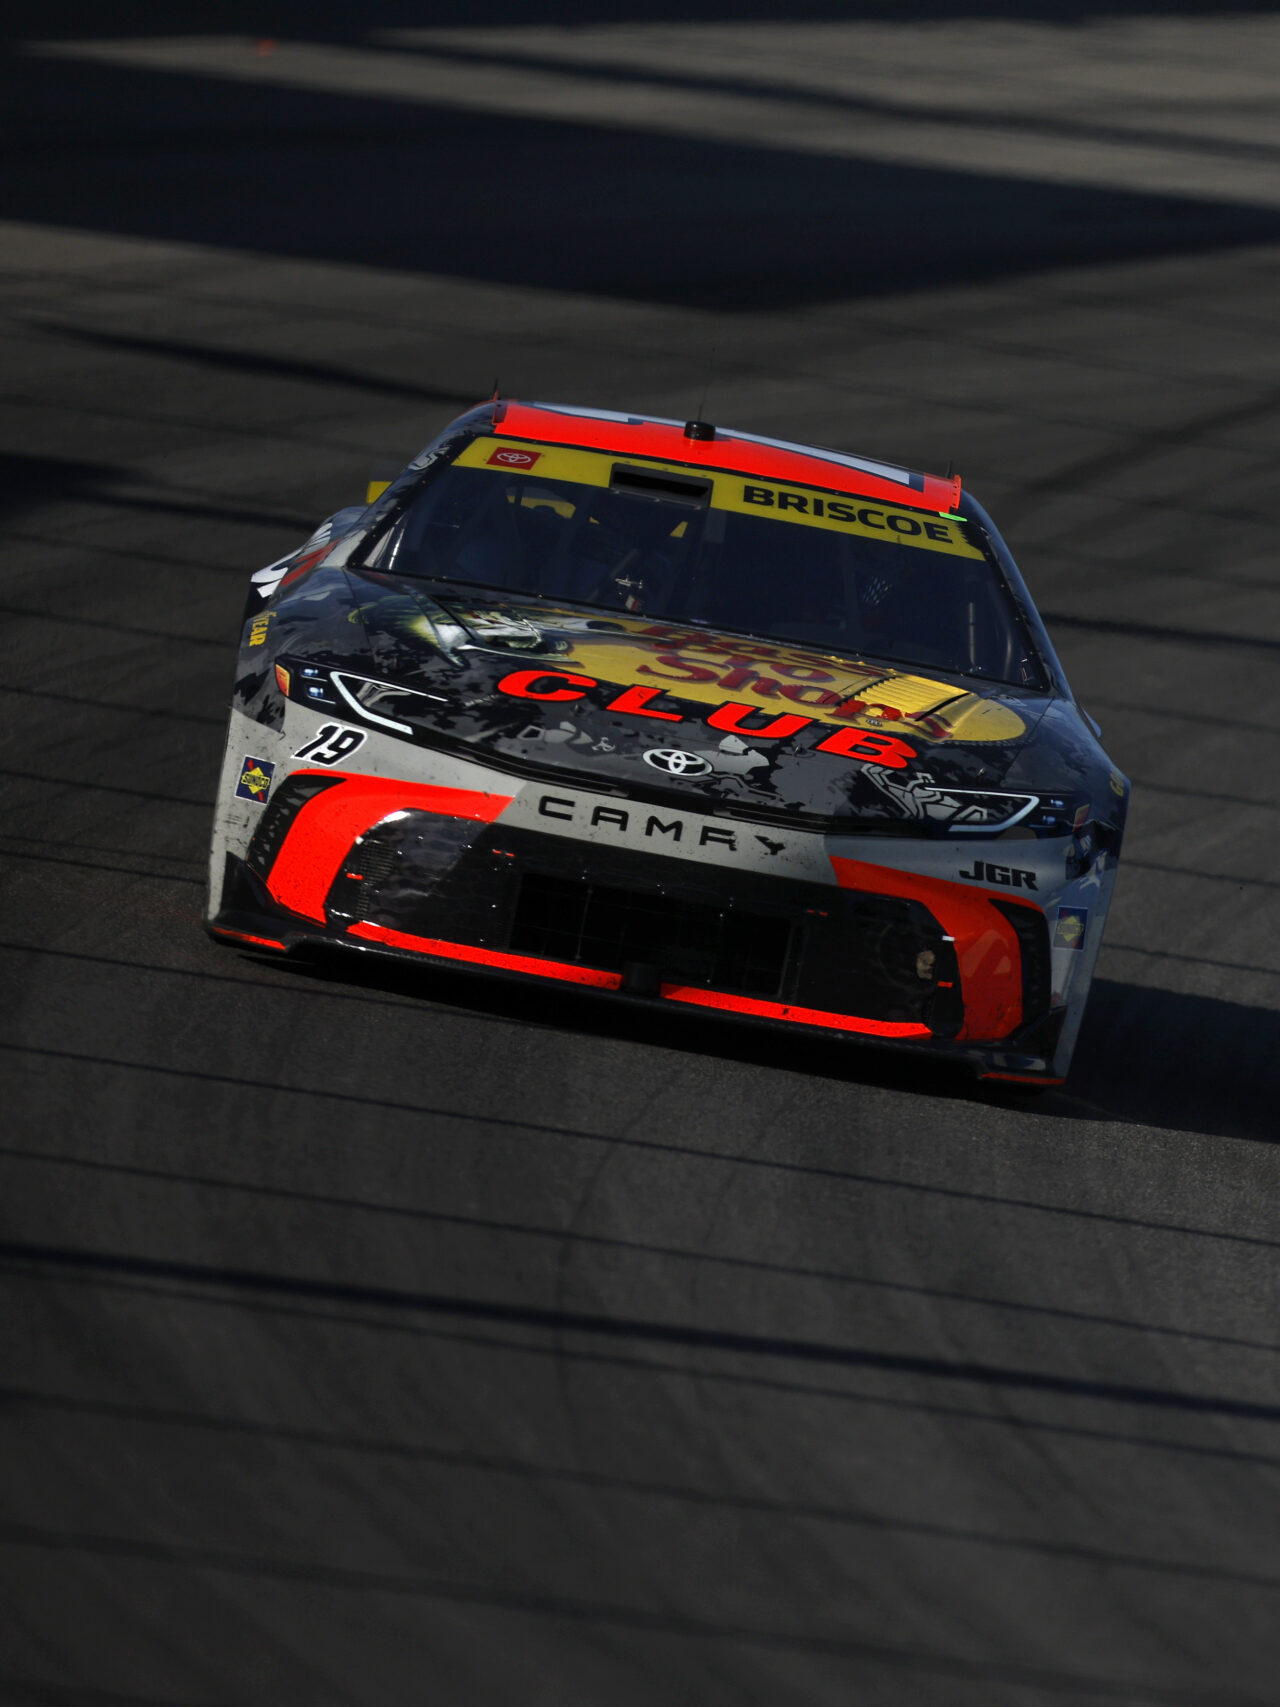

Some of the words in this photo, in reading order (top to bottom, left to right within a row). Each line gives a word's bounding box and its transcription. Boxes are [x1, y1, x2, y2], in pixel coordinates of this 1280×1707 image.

[743, 484, 954, 544] BRISCOE
[652, 637, 837, 683] Pro
[497, 669, 919, 769] CLUB
[636, 654, 955, 741] Shops
[292, 723, 366, 766] 19
[538, 795, 787, 856] CAMRY
[958, 860, 1039, 891] JGR
